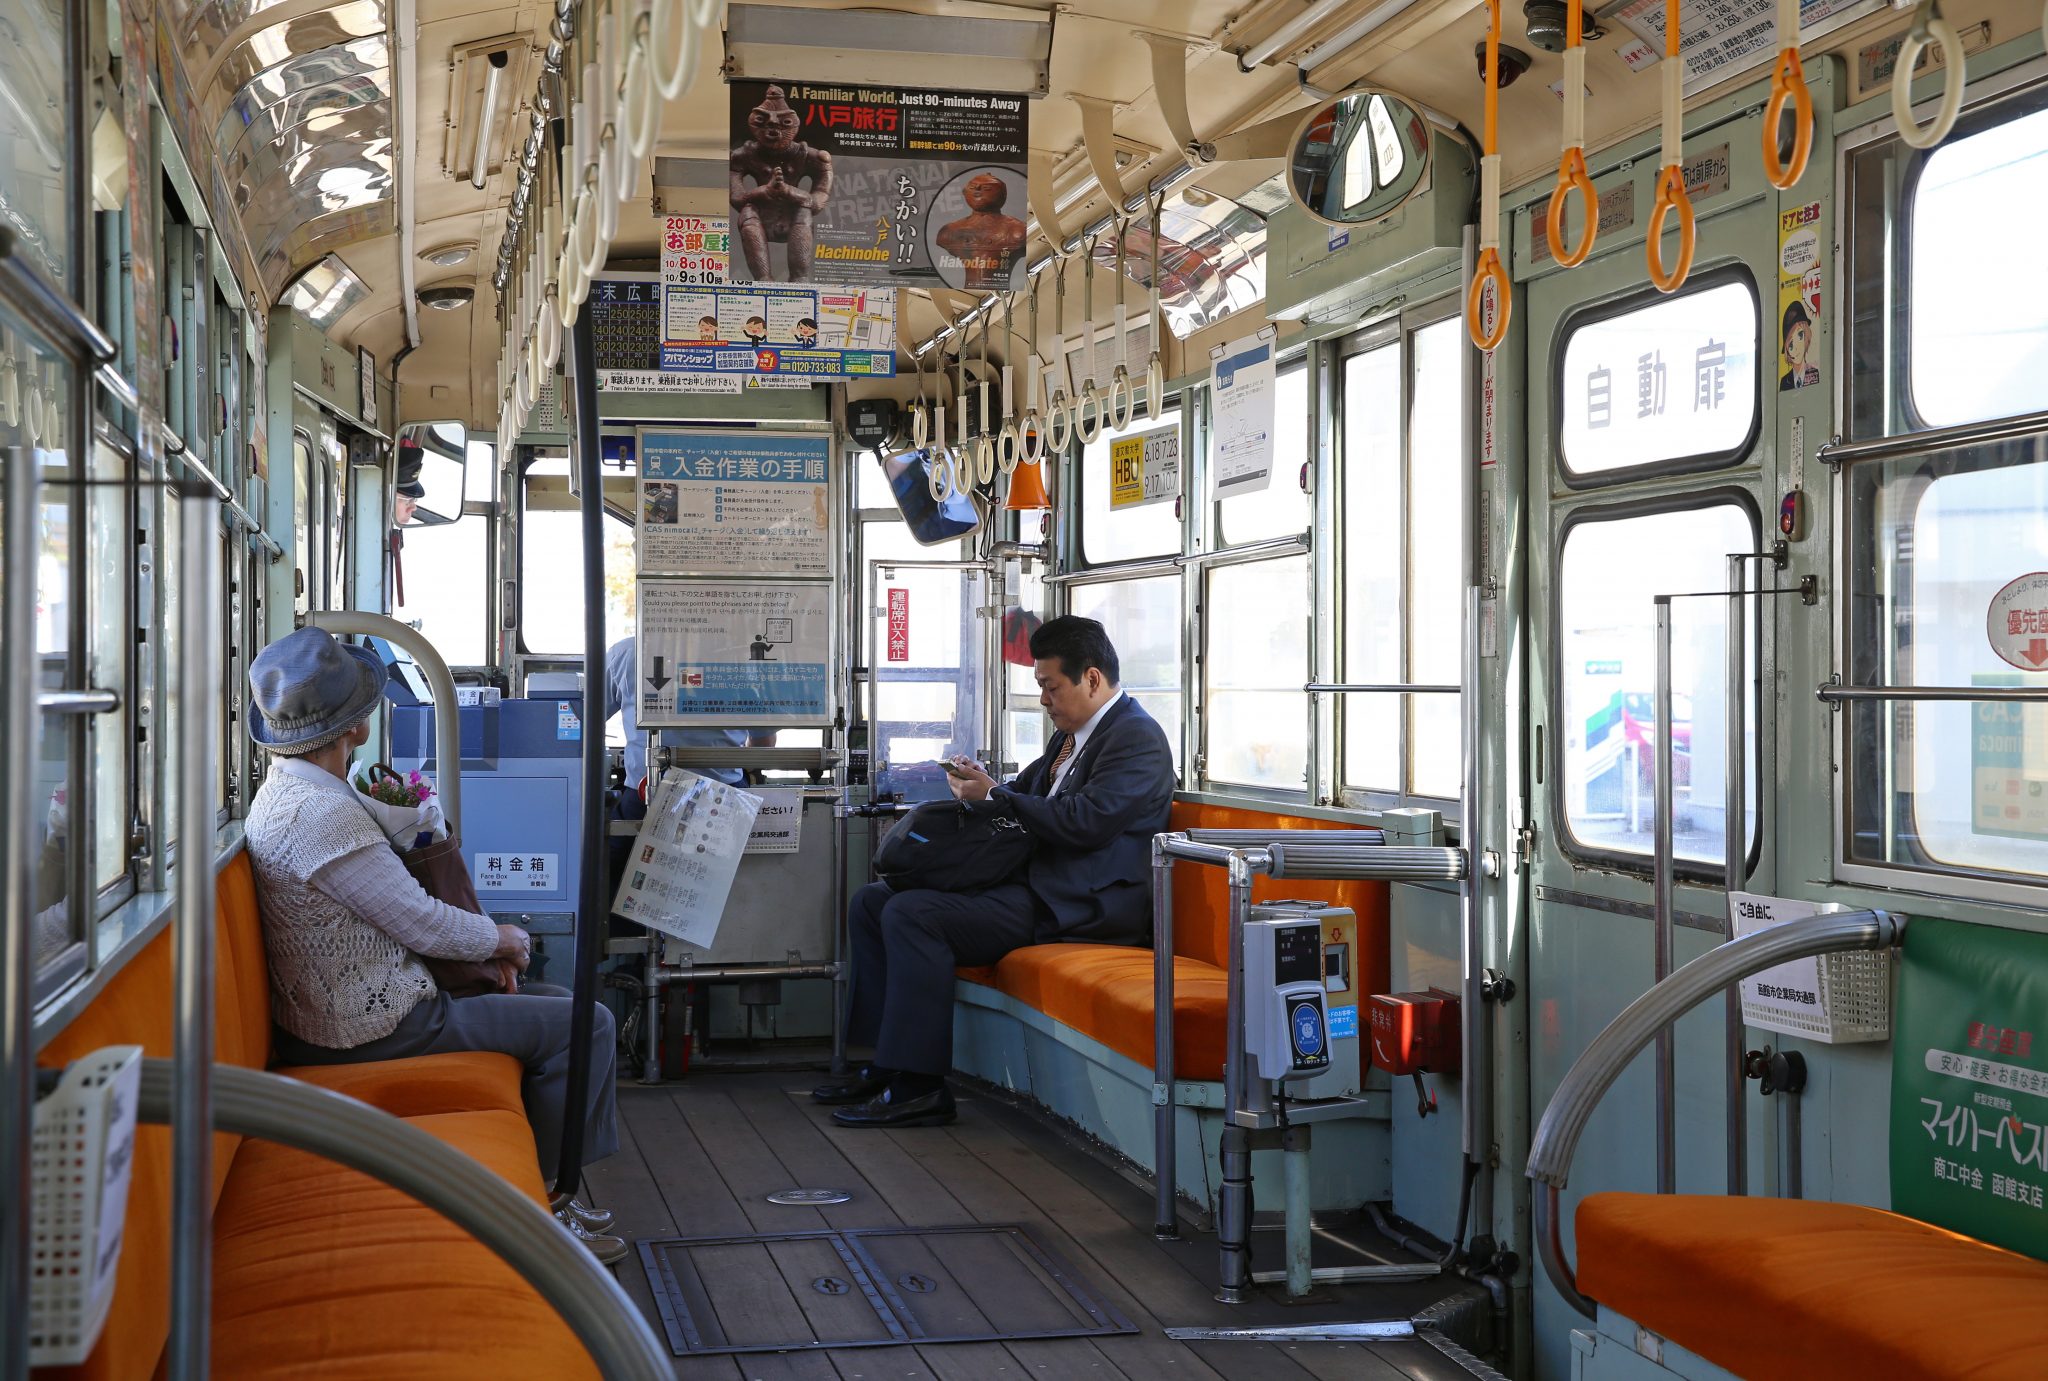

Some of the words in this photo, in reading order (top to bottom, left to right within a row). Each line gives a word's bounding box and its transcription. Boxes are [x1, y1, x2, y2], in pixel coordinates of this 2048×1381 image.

[790, 87, 799, 98] A
[803, 88, 854, 102] Familiar
[858, 90, 897, 105] World,
[898, 93, 924, 105] Just
[926, 95, 988, 108] 90-minutes
[990, 98, 1020, 112] Away
[806, 104, 898, 132] 八戸旅行
[1680, 157, 1727, 188] 方は前扉から
[666, 217, 706, 230] 2017年
[1782, 203, 1820, 230] ドアに注意
[815, 244, 890, 261] Hachinohe
[939, 256, 999, 268] Hakodate
[611, 309, 628, 319] 250
[630, 310, 648, 319] 250
[650, 310, 660, 320] 25
[611, 326, 628, 335] 240
[630, 326, 647, 336] 240
[650, 327, 660, 336] 24
[596, 342, 608, 351] 30
[611, 342, 628, 351] 230
[630, 343, 647, 352] 230
[650, 343, 660, 352] 23
[598, 359, 608, 367] 10
[611, 359, 628, 367] 210
[630, 359, 647, 368] 210
[664, 354, 714, 364] アパマンショップ
[792, 362, 840, 373] 0120-733-083
[1587, 337, 1726, 430] 自動扉
[1145, 442, 1160, 462] 6.18
[1162, 438, 1178, 458] 7.23
[672, 456, 824, 479] 入金作業の手順
[1116, 456, 1139, 484] HBU
[1145, 475, 1159, 494] 9.17
[890, 590, 906, 660] 運転席立入禁止
[758, 806, 793, 815] ださい！
[488, 857, 544, 871] 料金箱
[1740, 902, 1775, 921] ご自由に、
[1757, 983, 1816, 1005] 函館市企業局交通部
[1934, 1156, 1983, 1190] 商工中金
[1992, 1172, 2044, 1209] 函館支店
